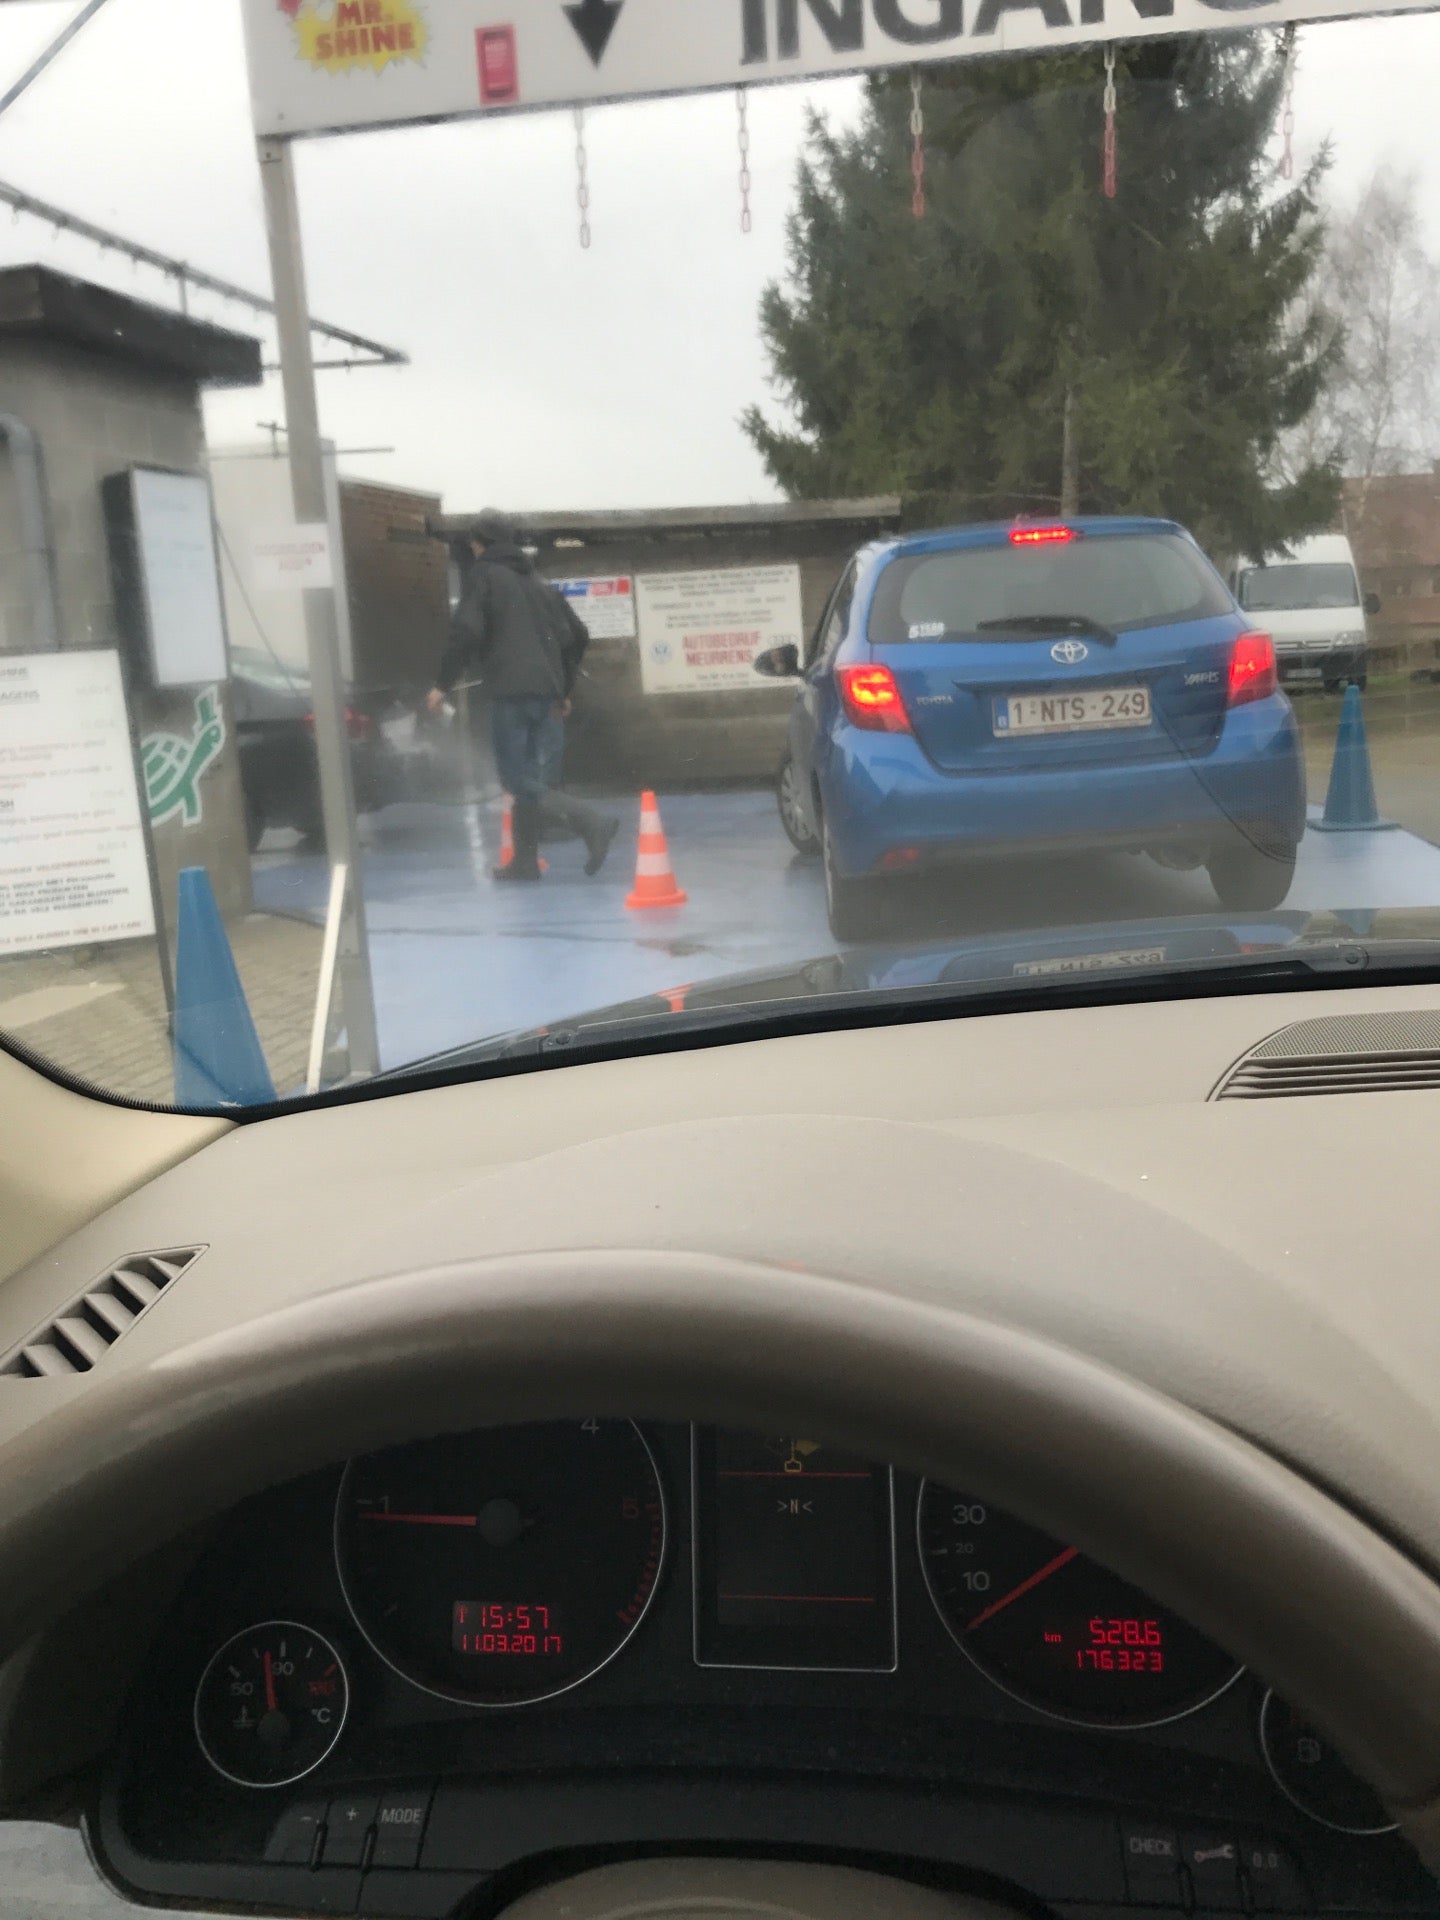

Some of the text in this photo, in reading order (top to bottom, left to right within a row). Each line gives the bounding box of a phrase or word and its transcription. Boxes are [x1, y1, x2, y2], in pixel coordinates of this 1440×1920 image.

[315, 23, 415, 60] SHINE
[739, 0, 1290, 66] ING
[953, 1504, 986, 1525] 30
[962, 1571, 990, 1591] 10
[481, 1605, 549, 1630] 15:57
[1089, 1618, 1161, 1646] 528.6
[272, 1661, 295, 1676] 90
[1076, 1649, 1163, 1672] 176323
[381, 1808, 423, 1824] MODE
